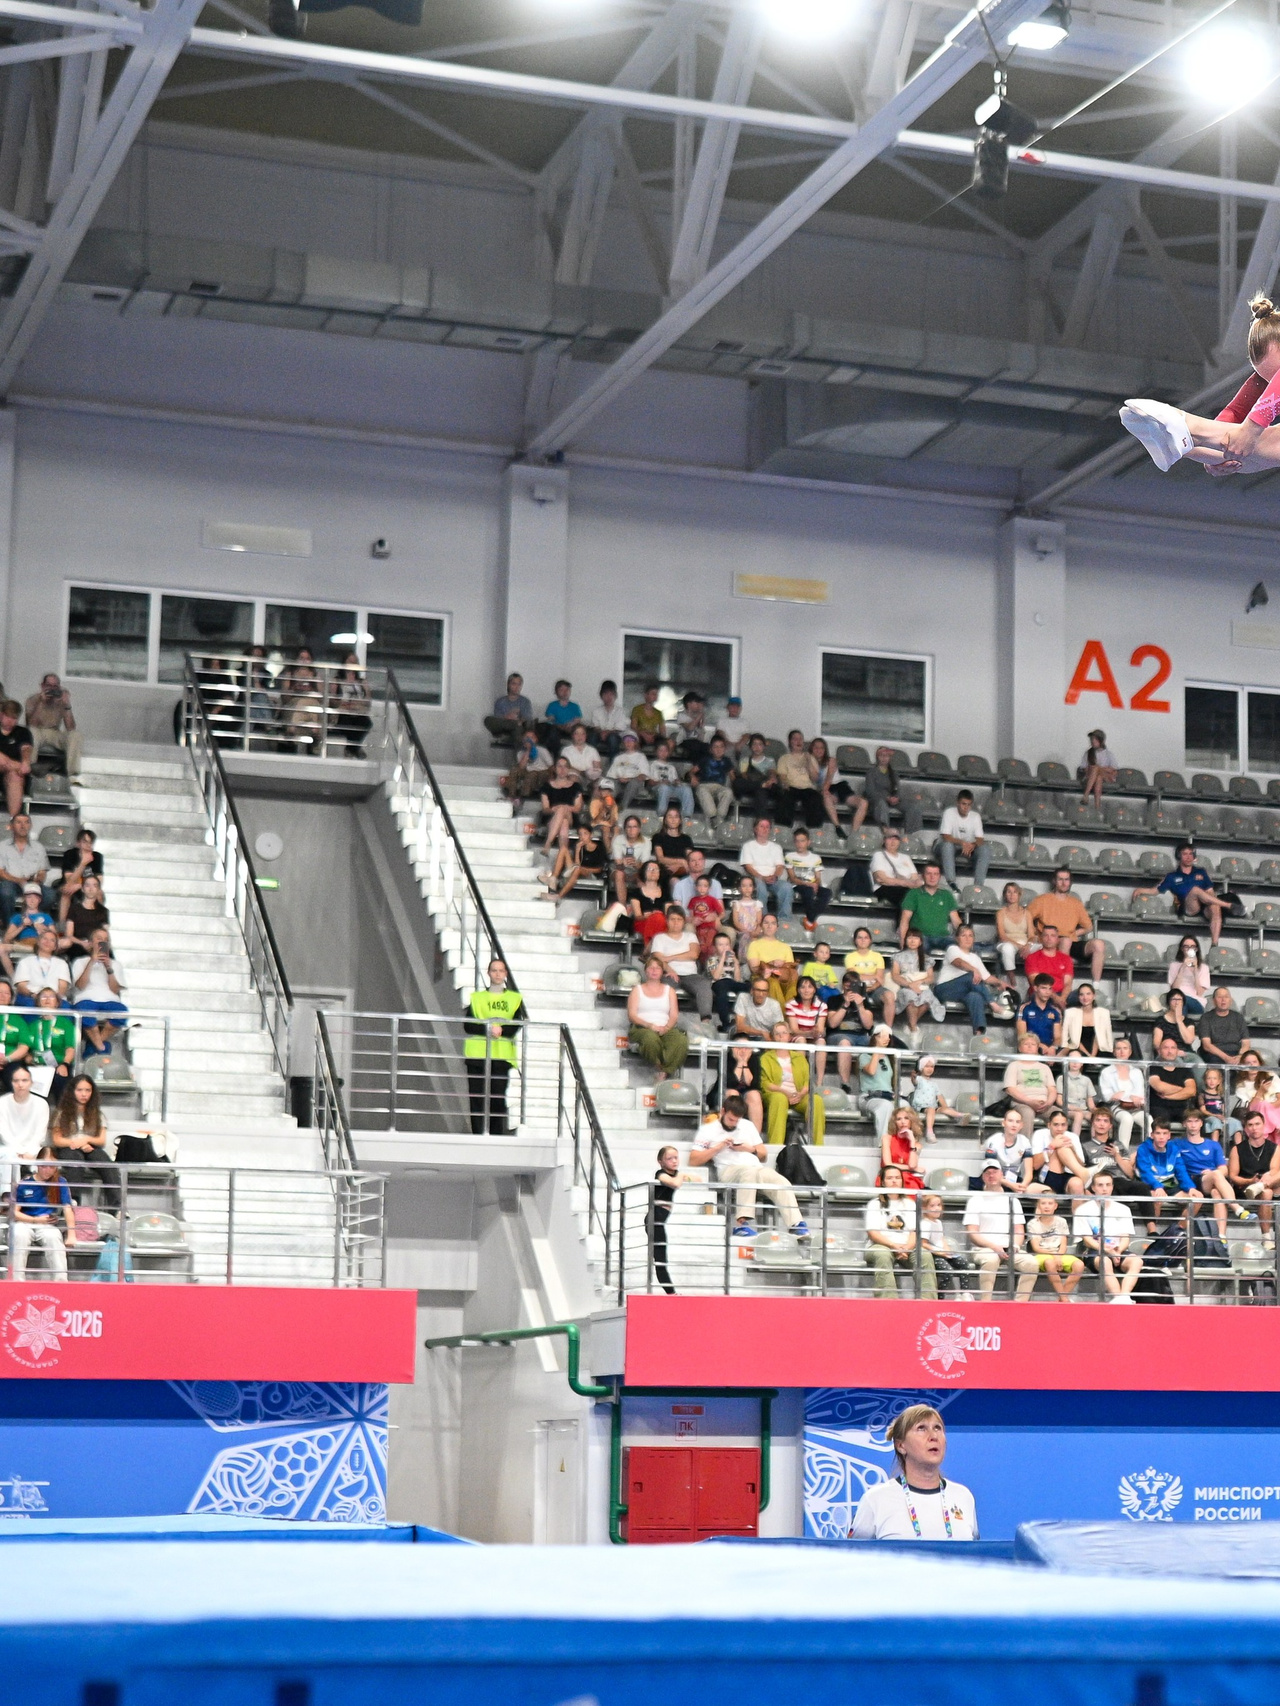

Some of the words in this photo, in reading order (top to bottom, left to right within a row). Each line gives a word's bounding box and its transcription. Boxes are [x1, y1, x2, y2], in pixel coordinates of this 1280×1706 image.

[1064, 640, 1172, 713] A2
[26, 1295, 61, 1304] РОССИИ
[936, 1312, 966, 1321] РОССИИ
[61, 1310, 103, 1338] 2026
[966, 1326, 1001, 1351] 2026
[680, 1421, 694, 1431] ПК
[1194, 1507, 1262, 1521] РОССИИ
